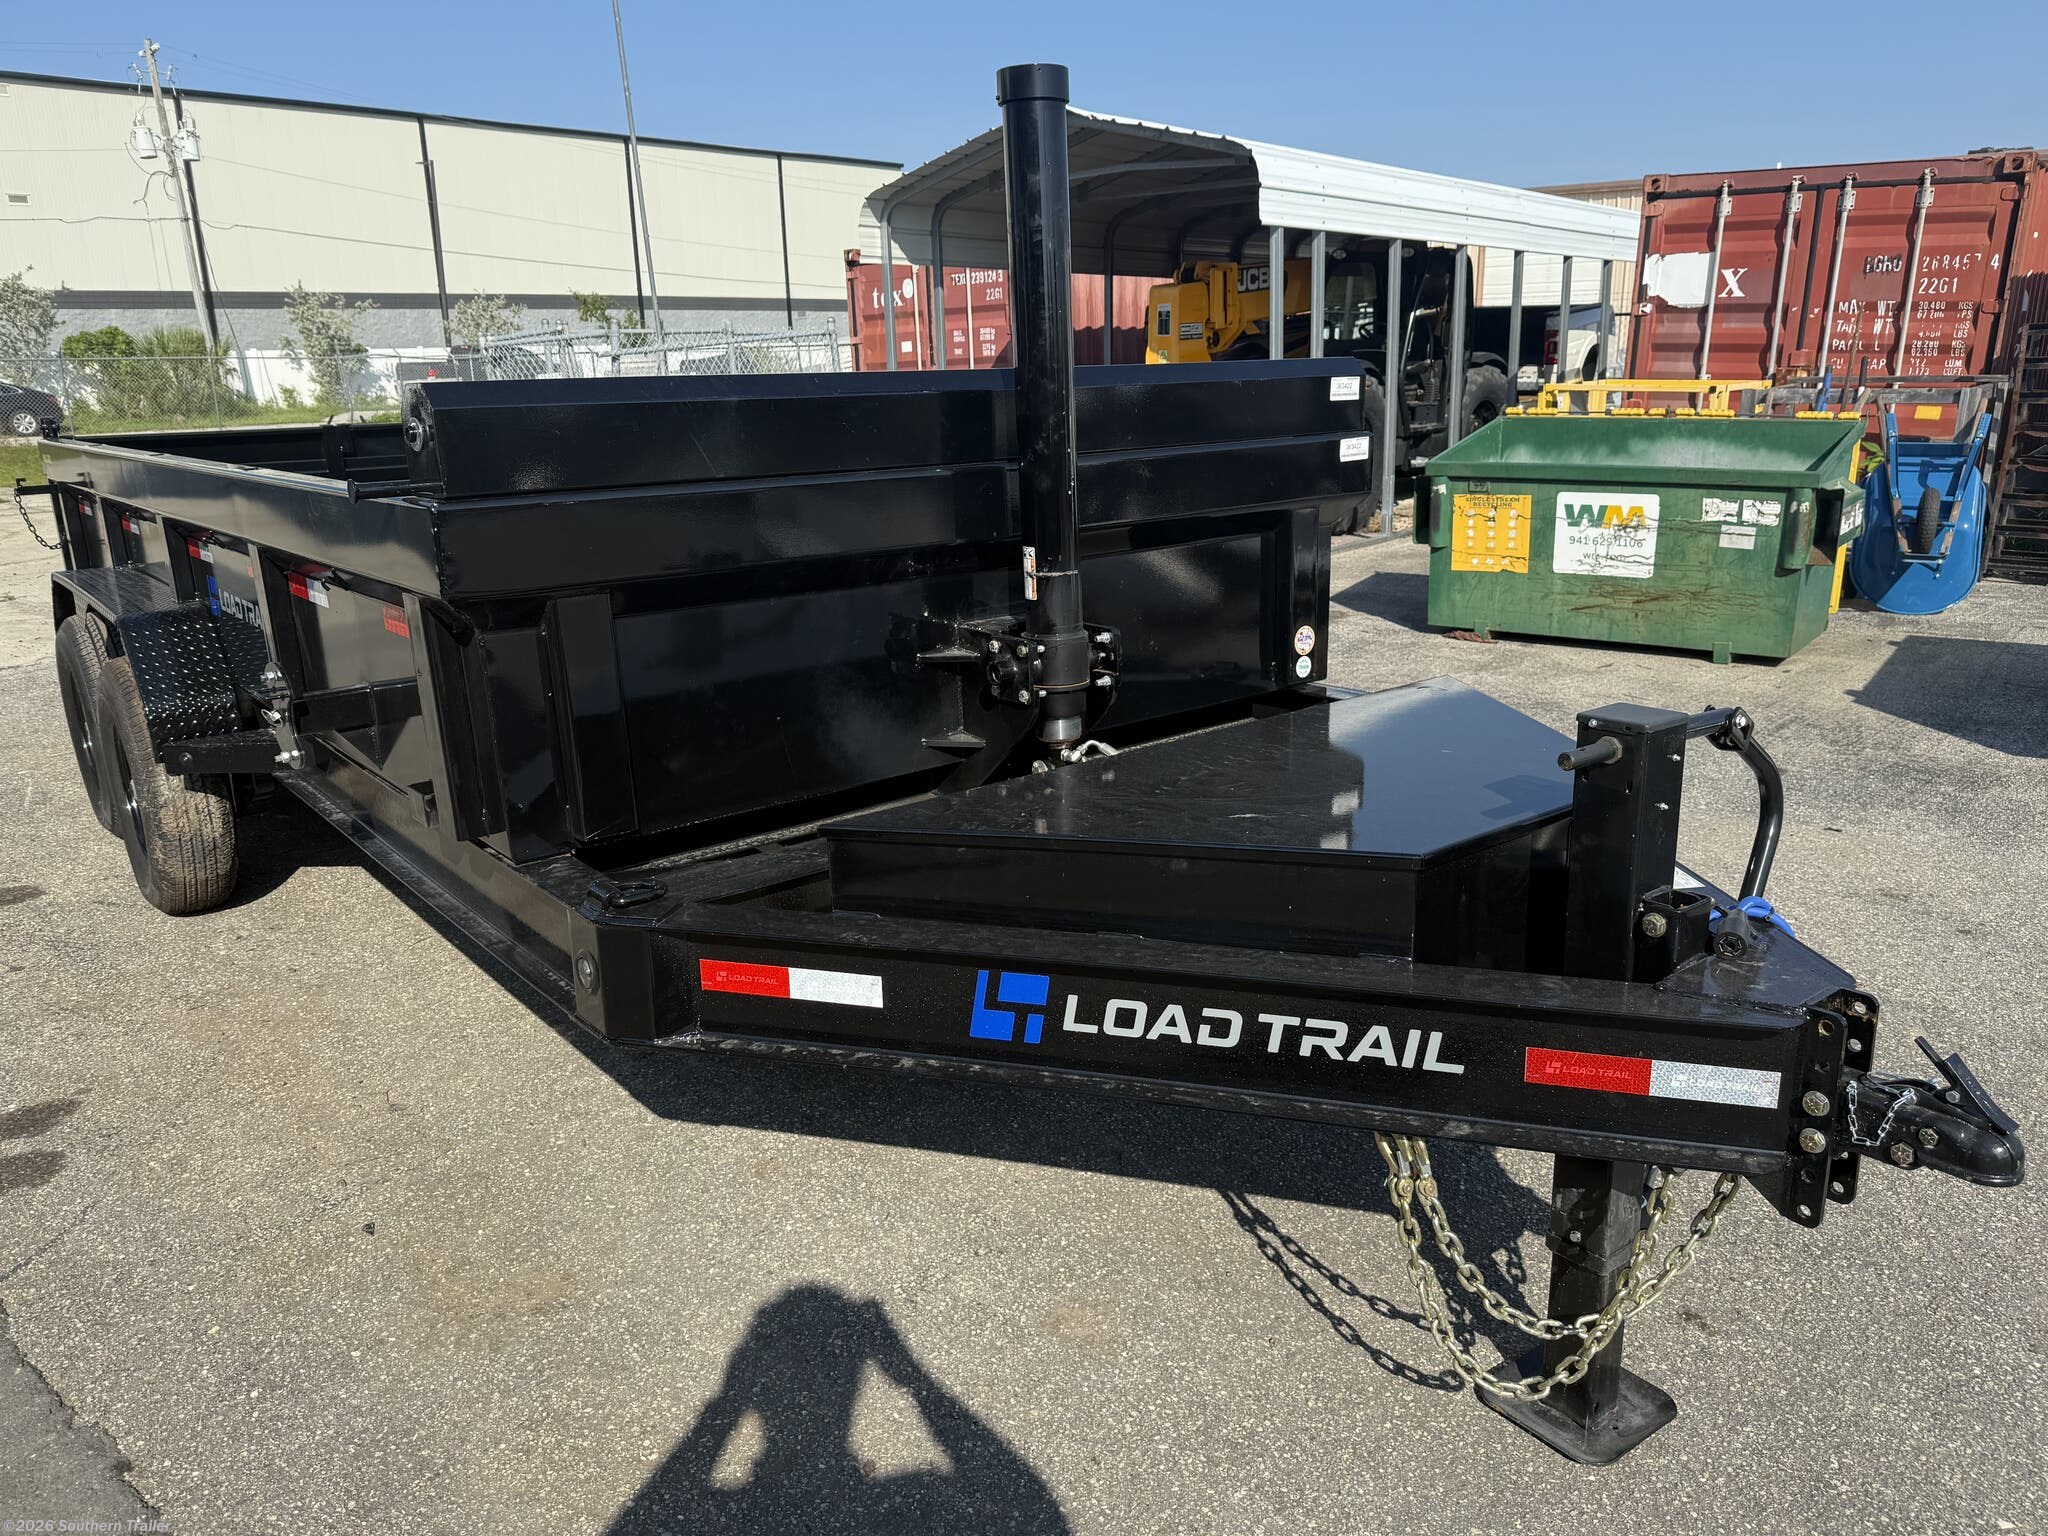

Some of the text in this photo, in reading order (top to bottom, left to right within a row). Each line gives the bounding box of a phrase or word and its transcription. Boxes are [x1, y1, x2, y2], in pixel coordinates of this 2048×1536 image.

[1991, 253, 2000, 270] 4
[1238, 267, 1270, 292] JCB
[1918, 277, 1958, 294] 22G1
[1564, 504, 1647, 529] WM
[1569, 535, 1590, 545] 941
[1616, 538, 1644, 548] 1106
[218, 588, 264, 630] LOAD TRA
[728, 974, 778, 985] LOAD TRAIL
[1062, 994, 1465, 1074] LOAD TRAIL
[1562, 1066, 1632, 1080] LOAD TRAIL
